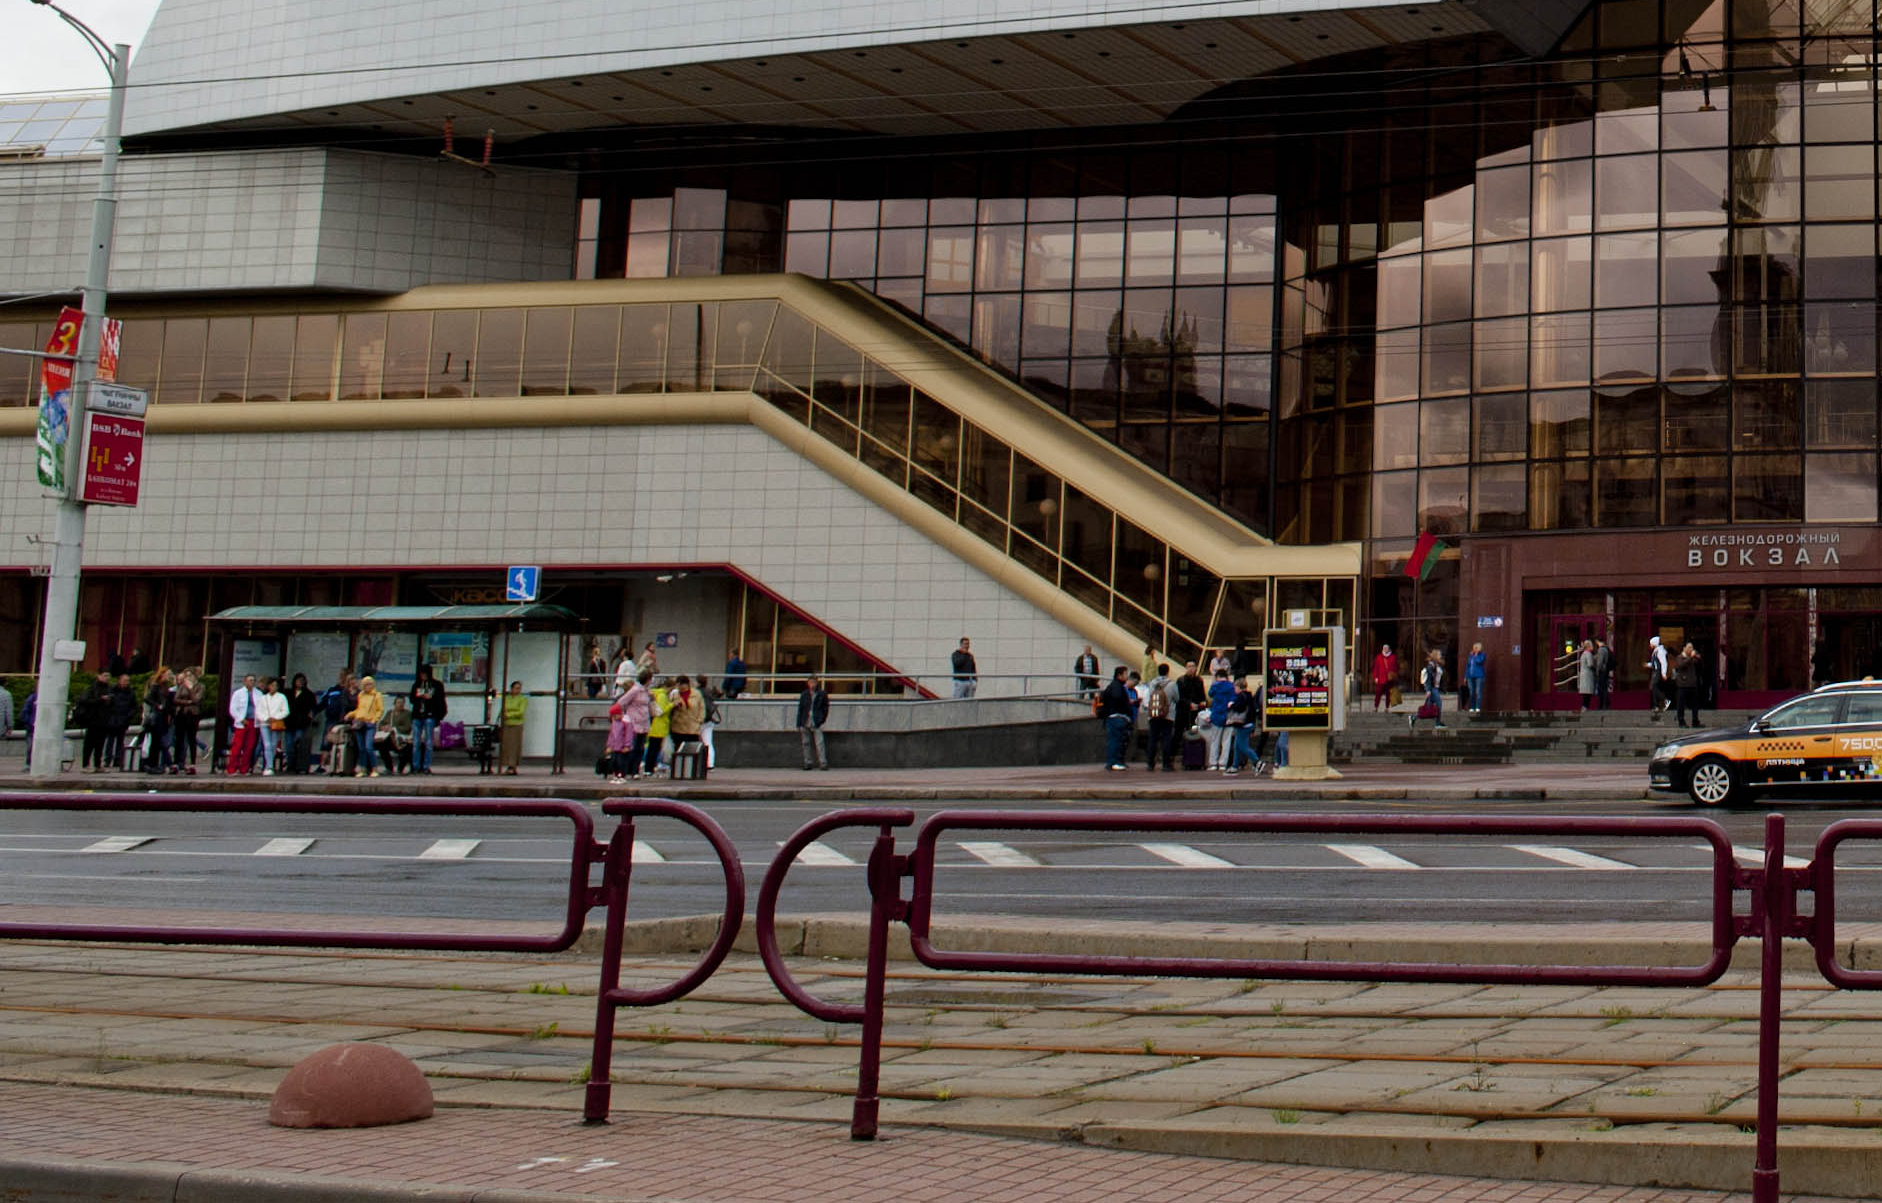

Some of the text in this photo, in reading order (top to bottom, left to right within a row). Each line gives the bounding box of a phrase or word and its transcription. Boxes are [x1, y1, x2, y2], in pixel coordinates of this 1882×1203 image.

[48, 322, 76, 354] 3
[1688, 532, 1840, 546] ЖЕЛЕЗНОДОРОЖНЫЙ
[1687, 548, 1840, 567] ВОКЗАЛ
